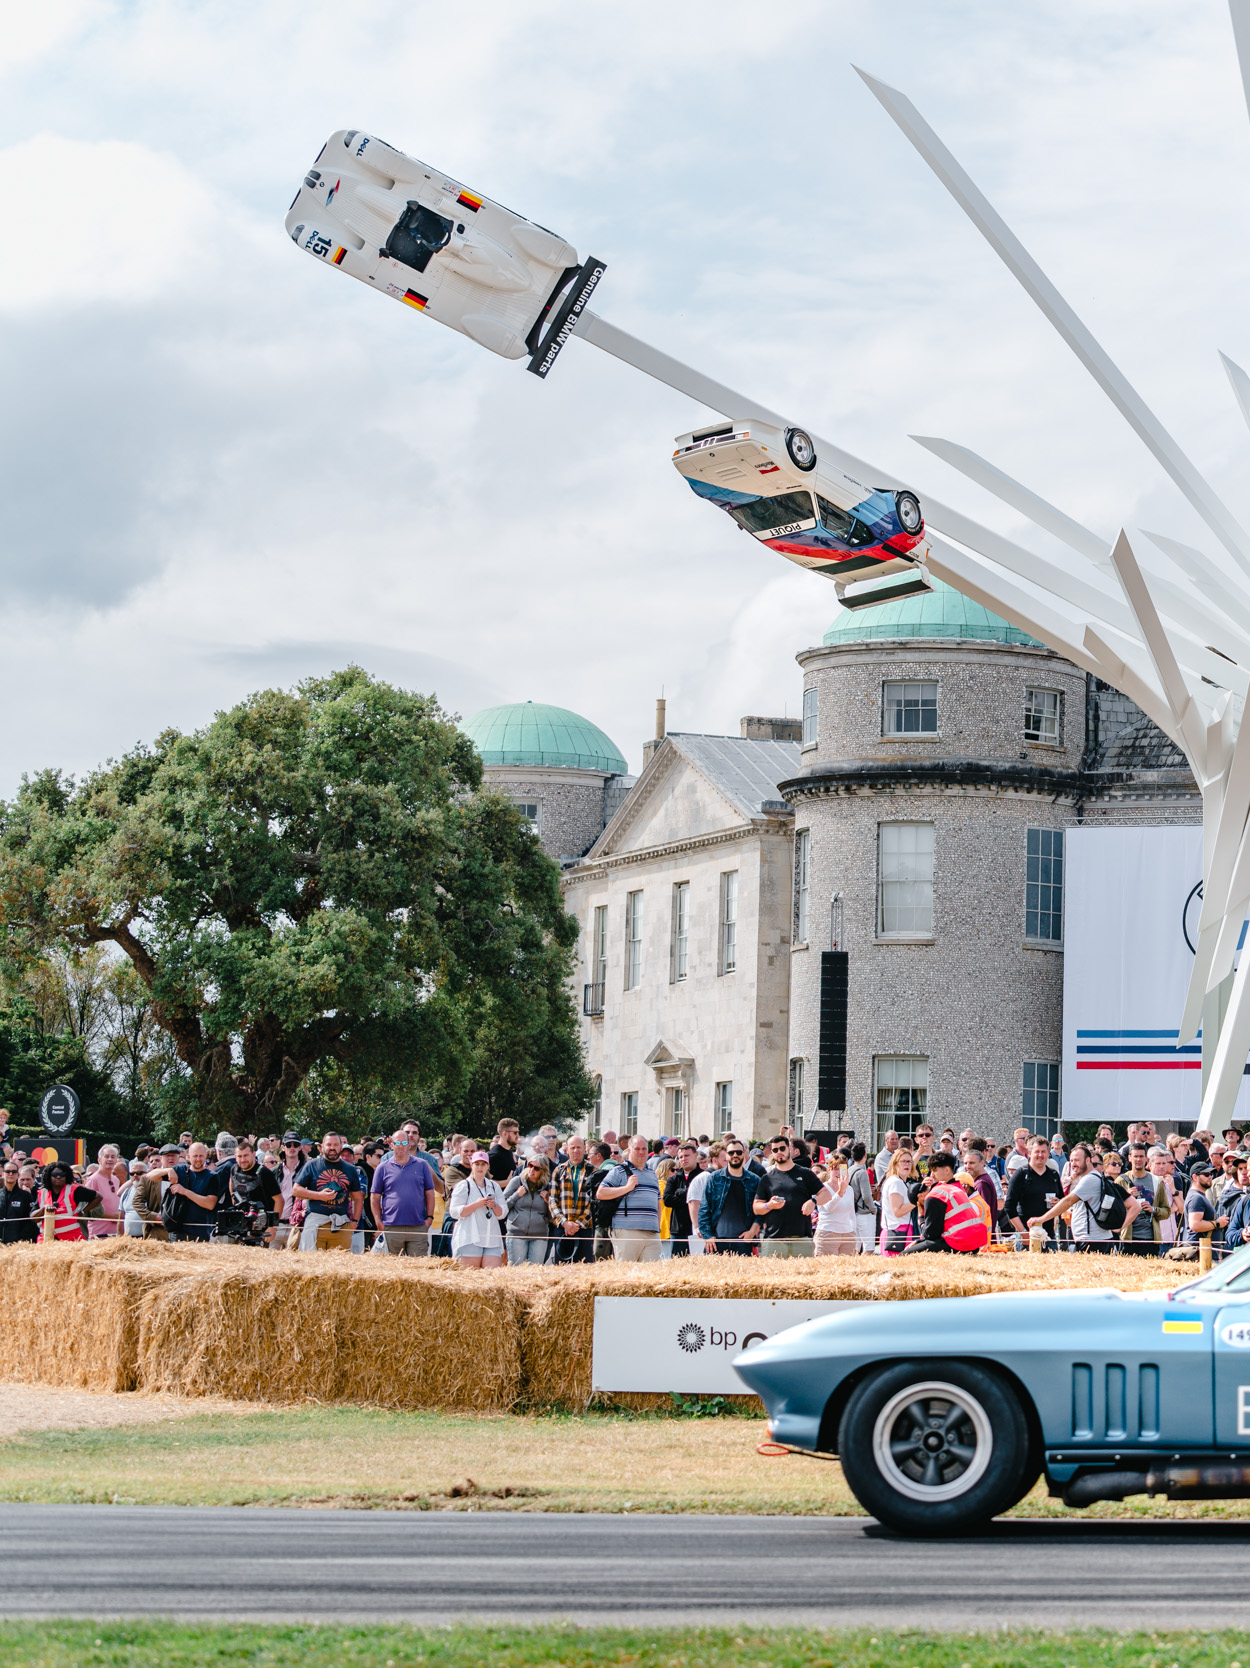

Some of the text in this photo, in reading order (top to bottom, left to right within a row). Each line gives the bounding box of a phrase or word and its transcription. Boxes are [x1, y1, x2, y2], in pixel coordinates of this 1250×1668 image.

[312, 235, 332, 258] 15
[539, 267, 603, 373] Genuine BMW parts
[769, 523, 801, 537] PIQUET
[709, 1327, 737, 1350] bp
